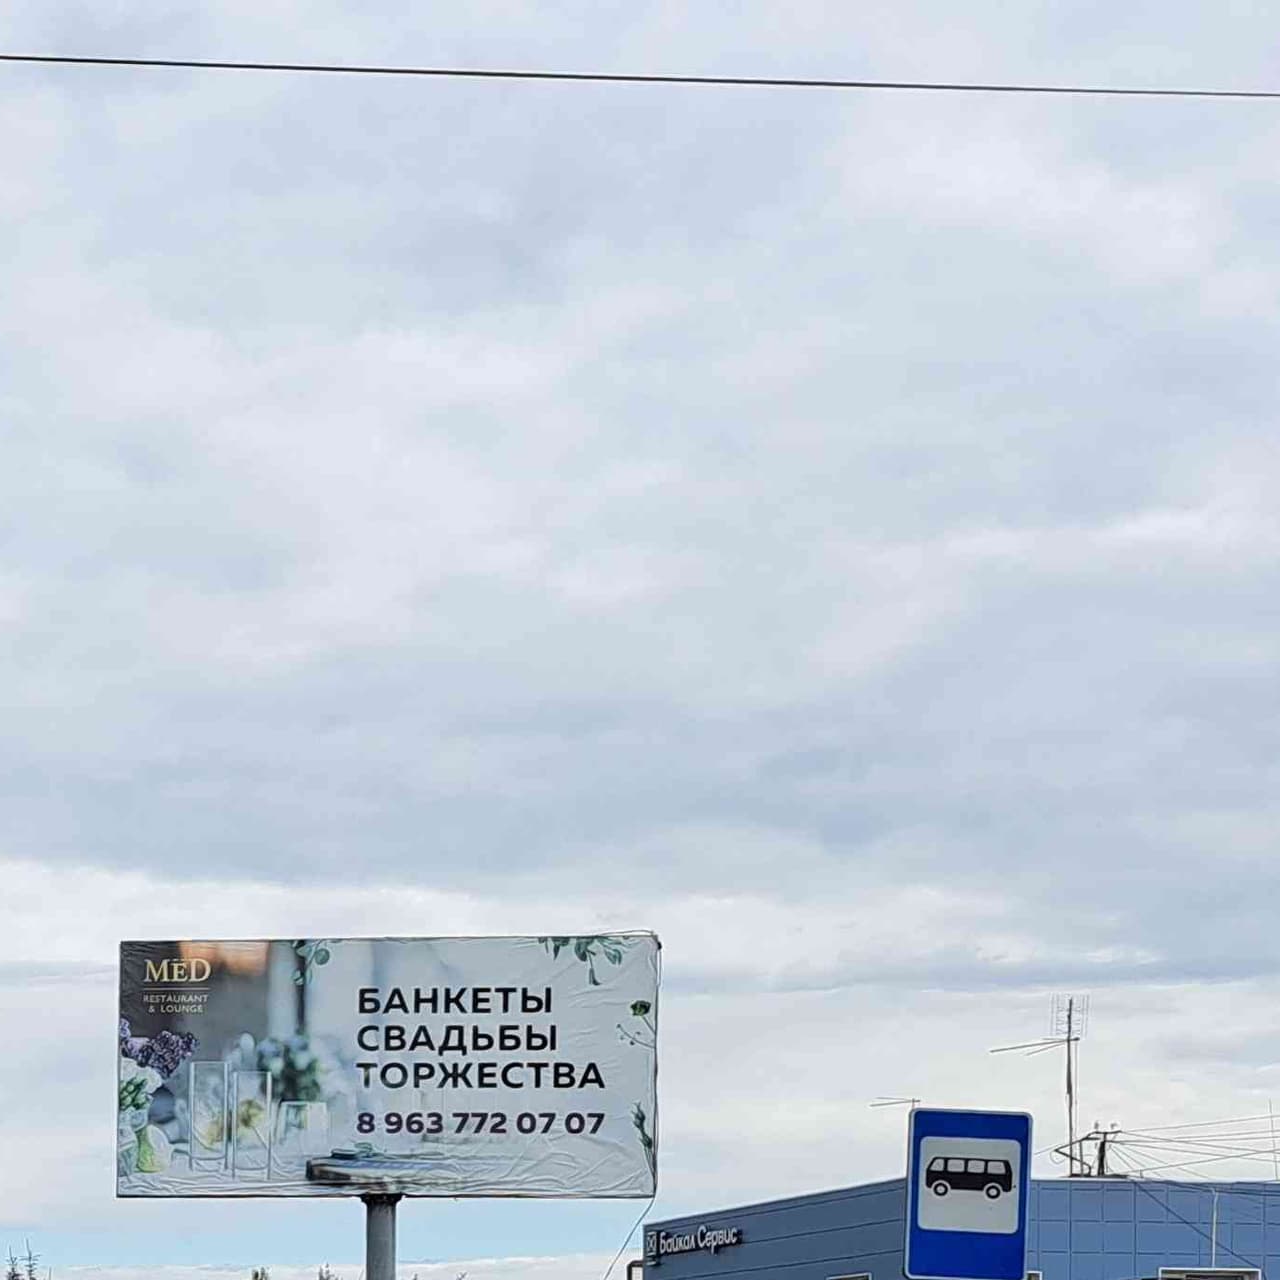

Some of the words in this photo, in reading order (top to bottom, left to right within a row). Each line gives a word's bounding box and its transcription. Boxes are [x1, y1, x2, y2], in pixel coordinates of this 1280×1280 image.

[143, 994, 209, 1003] RESTAURANT
[160, 1004, 203, 1013] LOUNGE
[358, 987, 552, 1014] БАНКЕТЫ
[357, 1025, 557, 1056] СВАДЬБЫ
[356, 1062, 606, 1089] ТОРЖЕСТВА
[357, 1112, 376, 1134] 8
[384, 1112, 444, 1134] 963
[452, 1112, 508, 1134] 772
[516, 1112, 556, 1134] 07
[565, 1112, 606, 1134] 07
[659, 1231, 696, 1254] Байкал
[697, 1225, 739, 1254] Сервис
